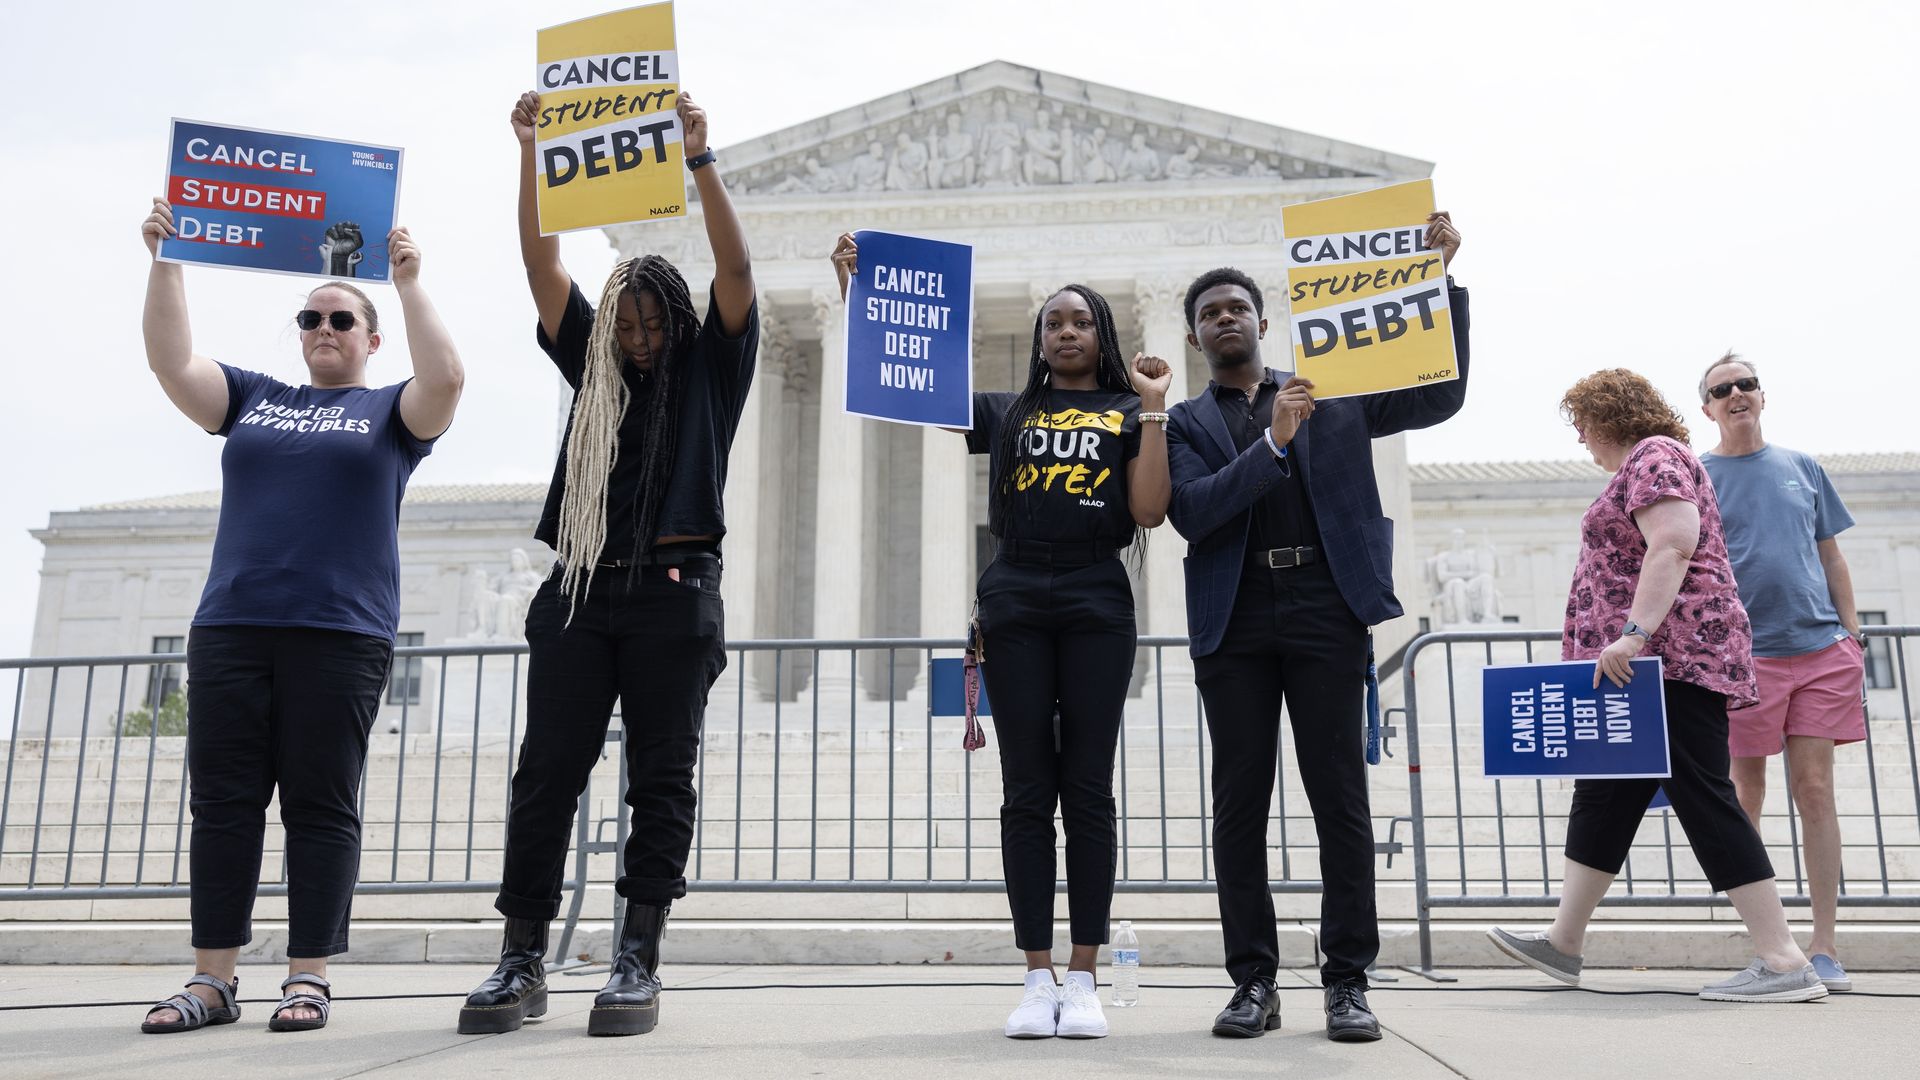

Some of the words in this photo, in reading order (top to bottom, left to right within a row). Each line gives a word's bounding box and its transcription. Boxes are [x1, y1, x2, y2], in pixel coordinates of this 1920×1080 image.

[543, 55, 669, 88] CANCEL
[538, 88, 676, 129] STUDENT
[186, 138, 313, 173] CANCEL
[352, 151, 375, 160] YOUNG
[352, 159, 394, 170] INVINCIBLES
[543, 119, 675, 188] DEBT
[181, 179, 322, 214] STUDENT
[649, 205, 681, 216] NAACP
[178, 216, 264, 246] DEBT
[1290, 228, 1432, 263] CANCEL
[874, 265, 945, 298] CANCEL
[1290, 258, 1440, 301] STUDENT
[866, 296, 951, 331] STUDENT
[1297, 287, 1441, 359] DEBT
[885, 331, 931, 360] DEBT
[880, 362, 934, 393] NOW!
[1418, 369, 1452, 382] NAACP
[239, 410, 371, 434] INVINCIBLES
[1004, 462, 1111, 498] OTE!
[1079, 499, 1105, 508] NAACP
[1511, 688, 1536, 753] CANCEL
[1541, 682, 1568, 759] STUDENT
[1572, 697, 1599, 740] DEBT
[1604, 693, 1633, 744] NOW!
